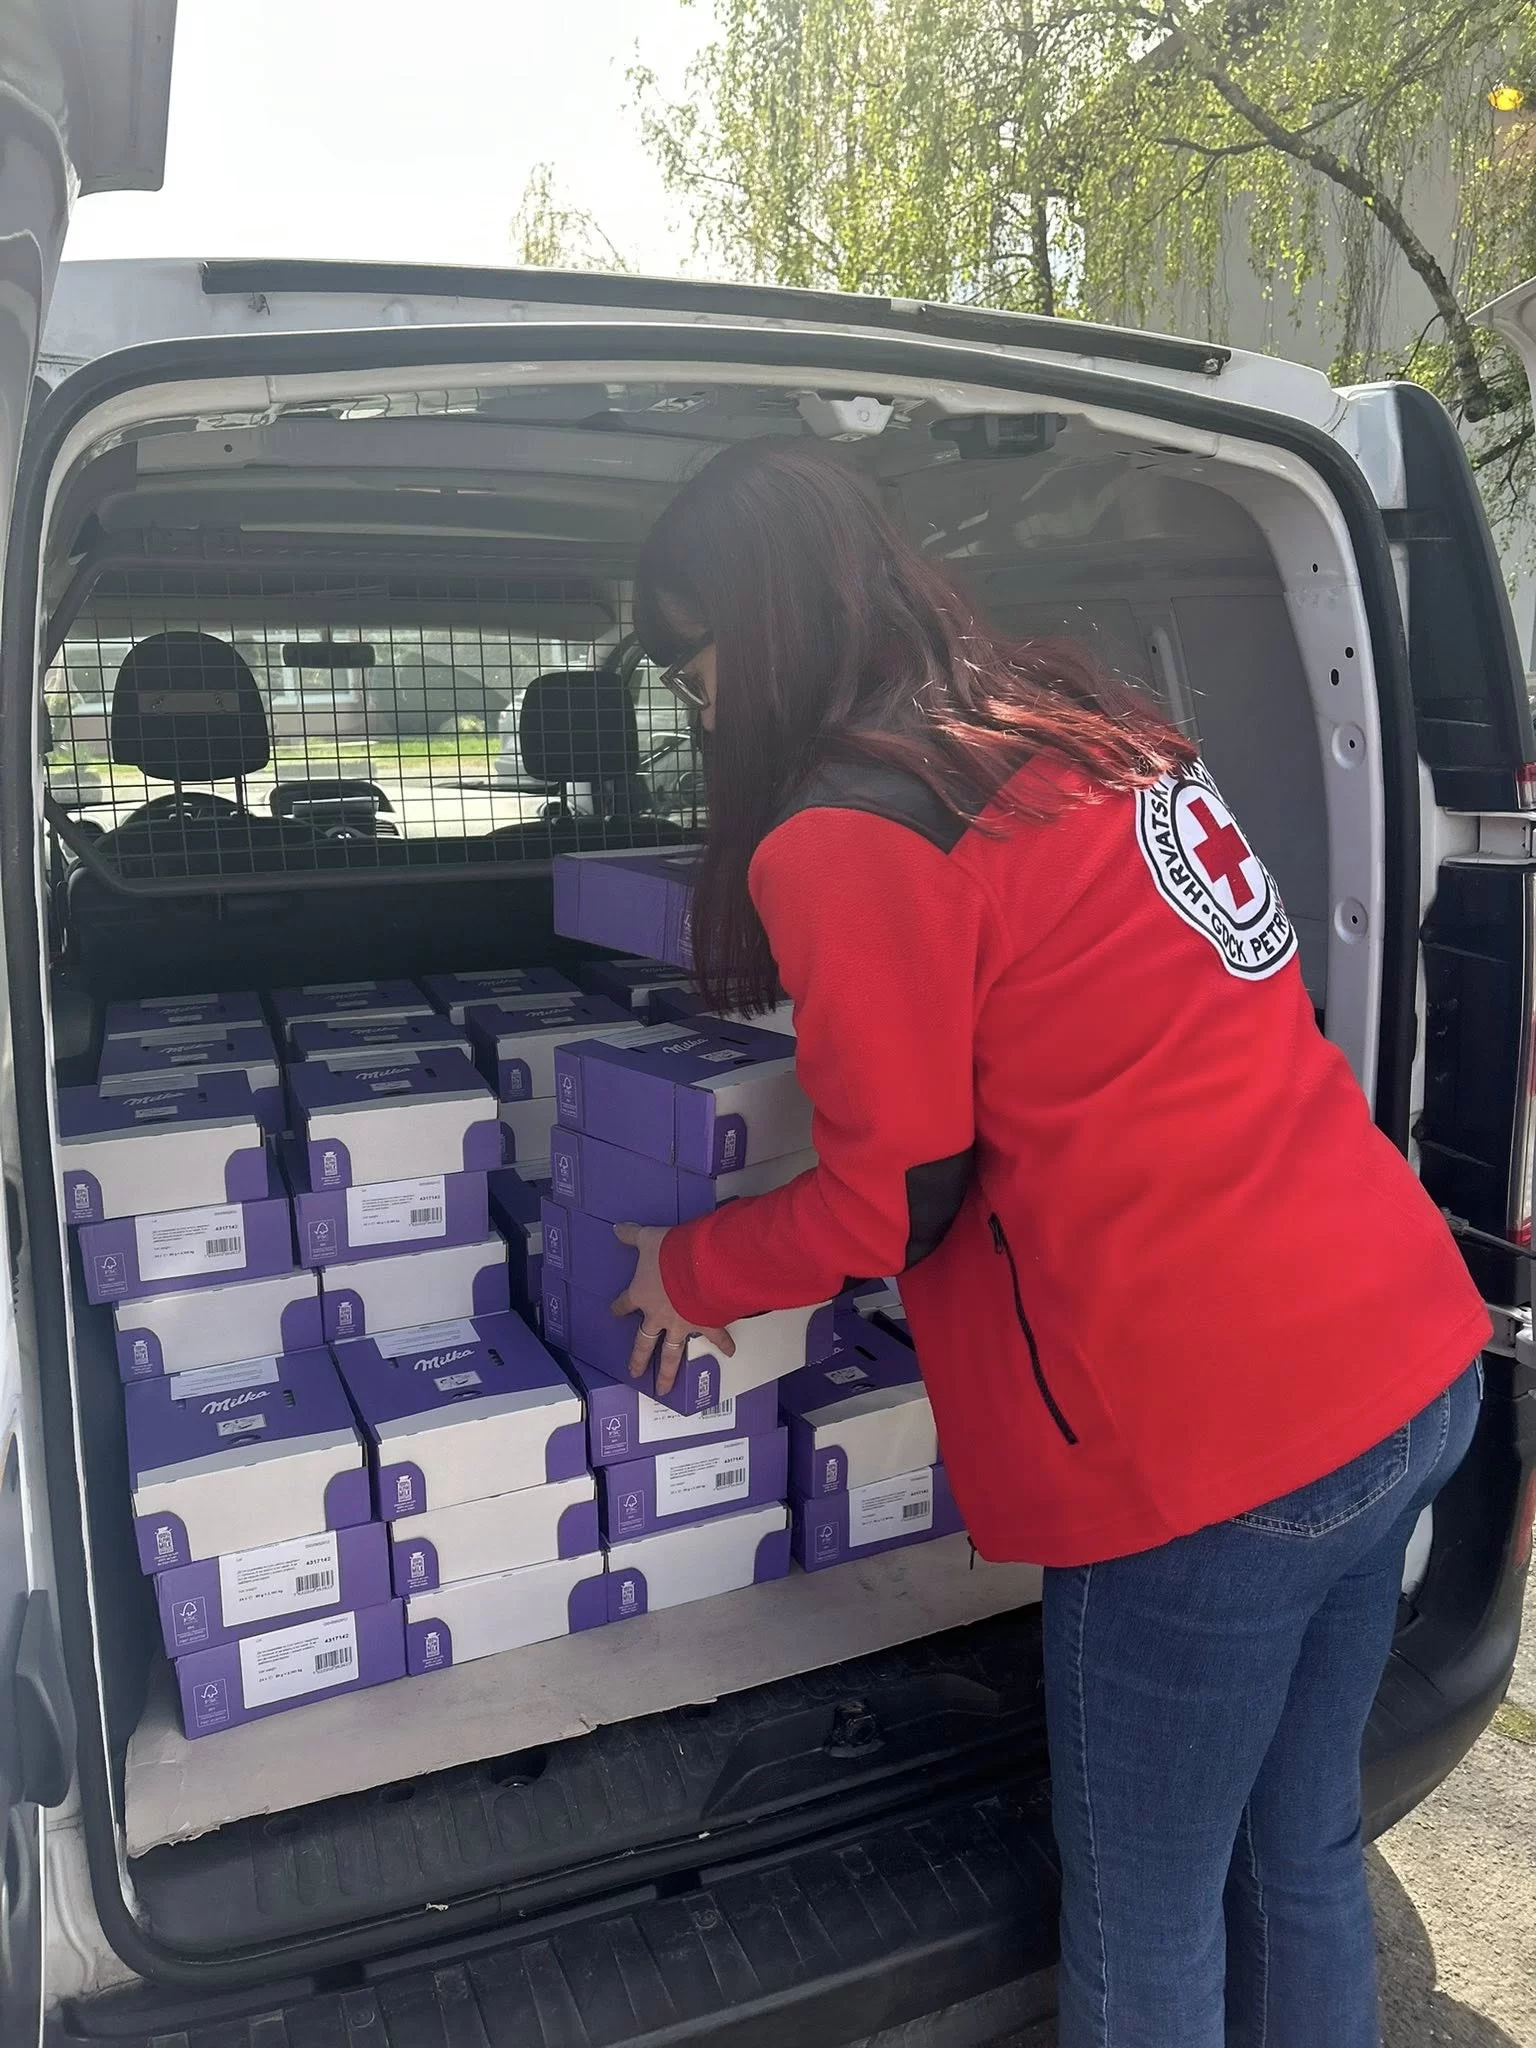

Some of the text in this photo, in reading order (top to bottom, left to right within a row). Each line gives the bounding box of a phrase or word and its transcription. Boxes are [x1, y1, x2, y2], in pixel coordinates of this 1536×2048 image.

[1149, 781, 1203, 906] HRVATSKI
[1211, 914, 1248, 963] GDCK
[662, 1036, 710, 1055] Milka
[355, 1067, 413, 1080] Milka
[122, 1091, 187, 1106] Milka
[413, 1348, 476, 1372] Milka
[201, 1389, 272, 1415] Milka
